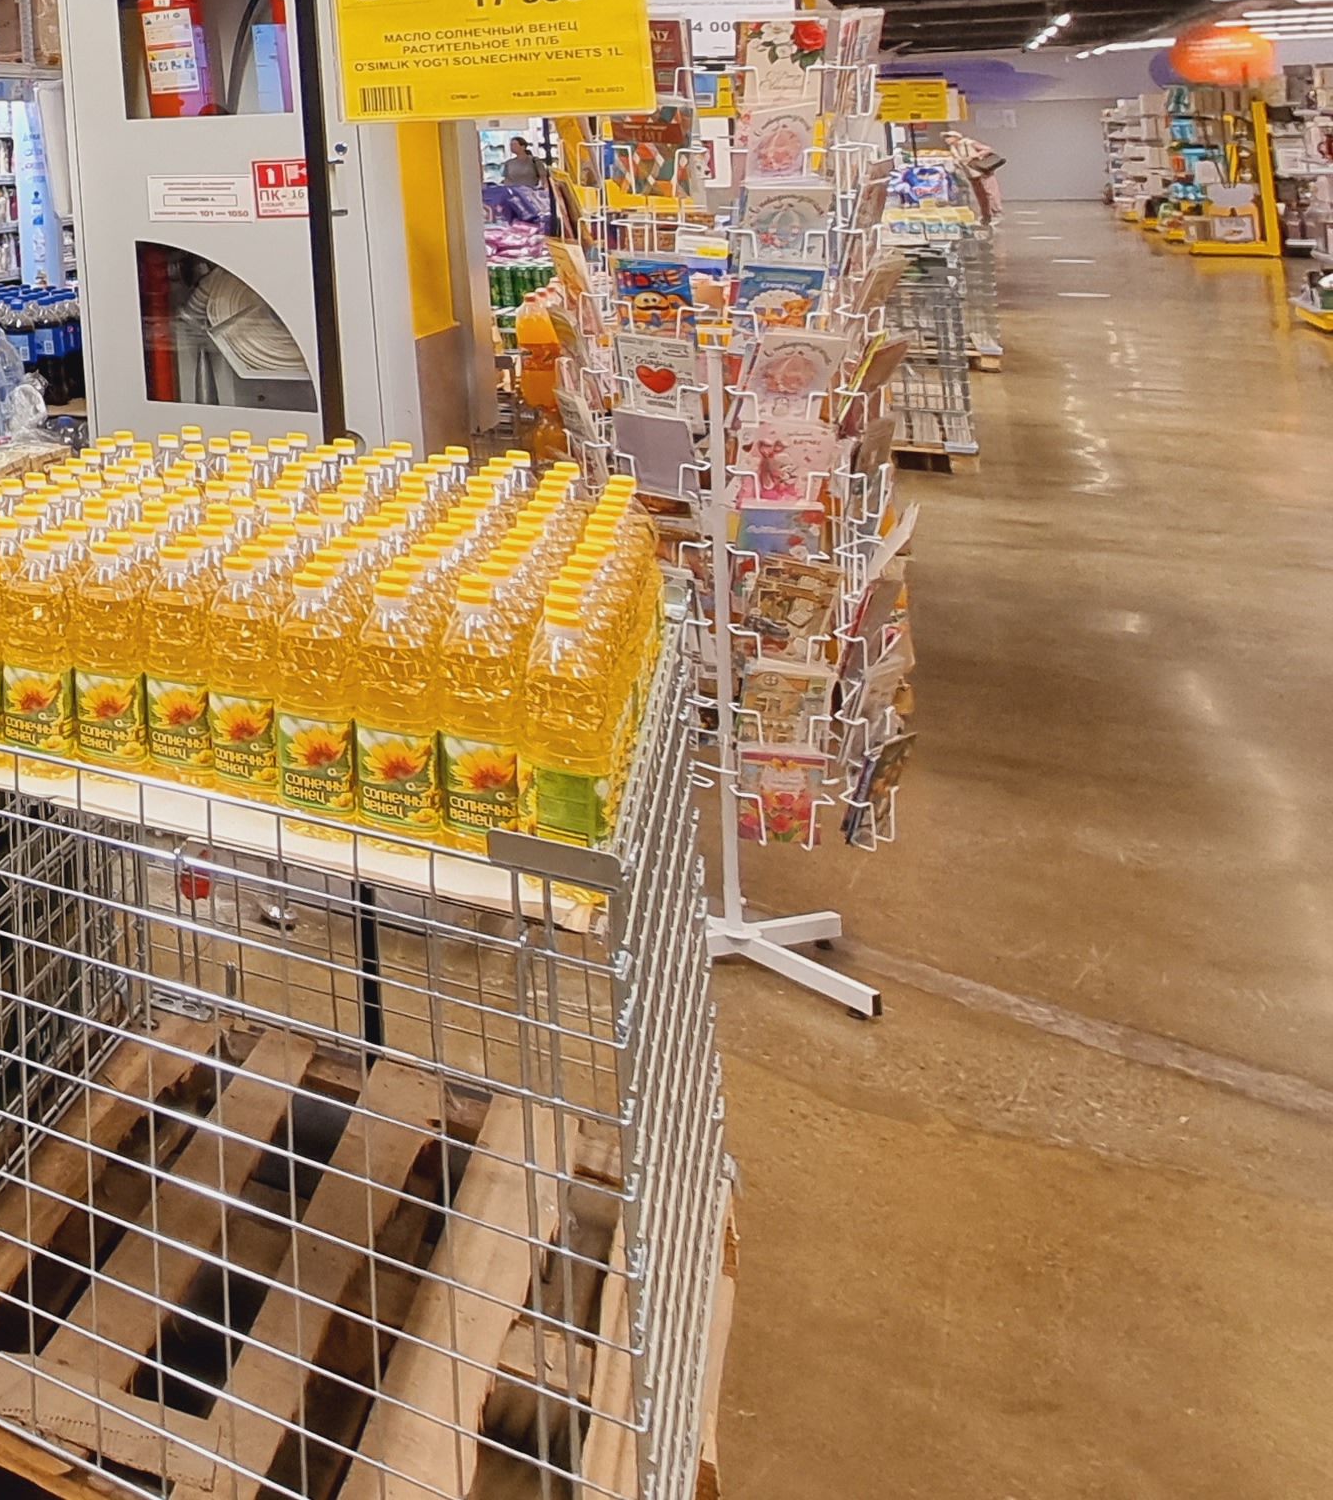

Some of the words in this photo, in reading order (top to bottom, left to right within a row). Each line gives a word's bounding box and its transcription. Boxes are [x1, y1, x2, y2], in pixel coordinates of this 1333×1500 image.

[384, 30, 432, 44] МАСЛО
[435, 23, 525, 41] СОЛНЕЧНЫЙ
[529, 21, 578, 34] ВЕНЕЦ
[402, 39, 511, 55] РАСТИТЕЛЬНОЕ
[516, 37, 531, 48] 1Л
[536, 35, 560, 46] П/Б
[355, 59, 410, 73] O'SIMLIK
[452, 51, 542, 66] SOLNECHNIY
[545, 47, 602, 60] VENETS
[608, 46, 623, 56] 1L
[291, 190, 305, 199] 16
[449, 795, 518, 818] солнечны
